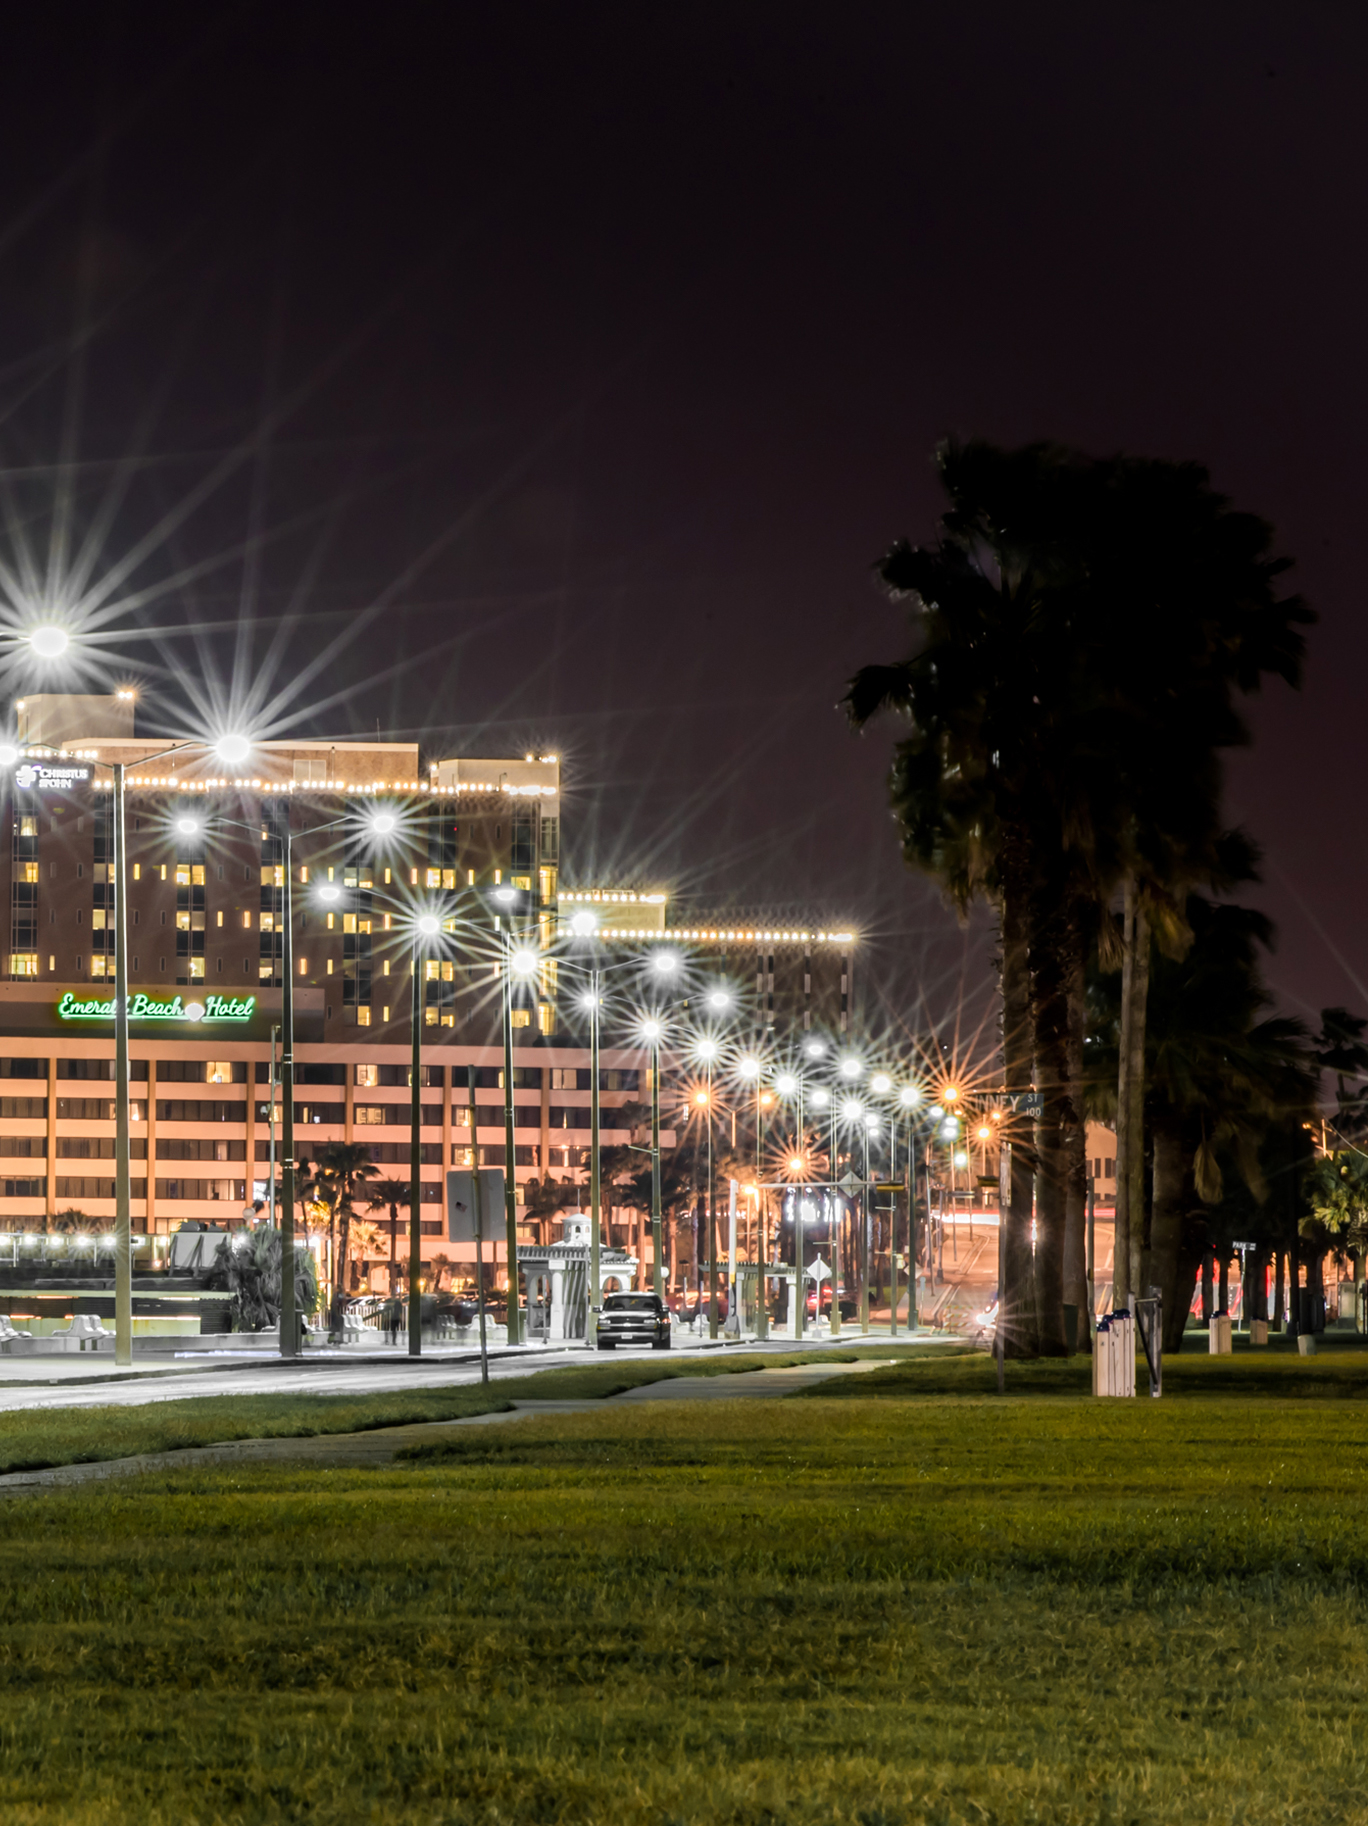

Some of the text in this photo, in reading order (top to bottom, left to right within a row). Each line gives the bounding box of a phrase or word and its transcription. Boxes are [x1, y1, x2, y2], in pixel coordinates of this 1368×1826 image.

[39, 768, 88, 779] CHRISTUS
[132, 994, 184, 1016] Beach
[205, 996, 256, 1017] Hotel
[1027, 1093, 1038, 1103] ST
[1026, 1107, 1041, 1117] 100
